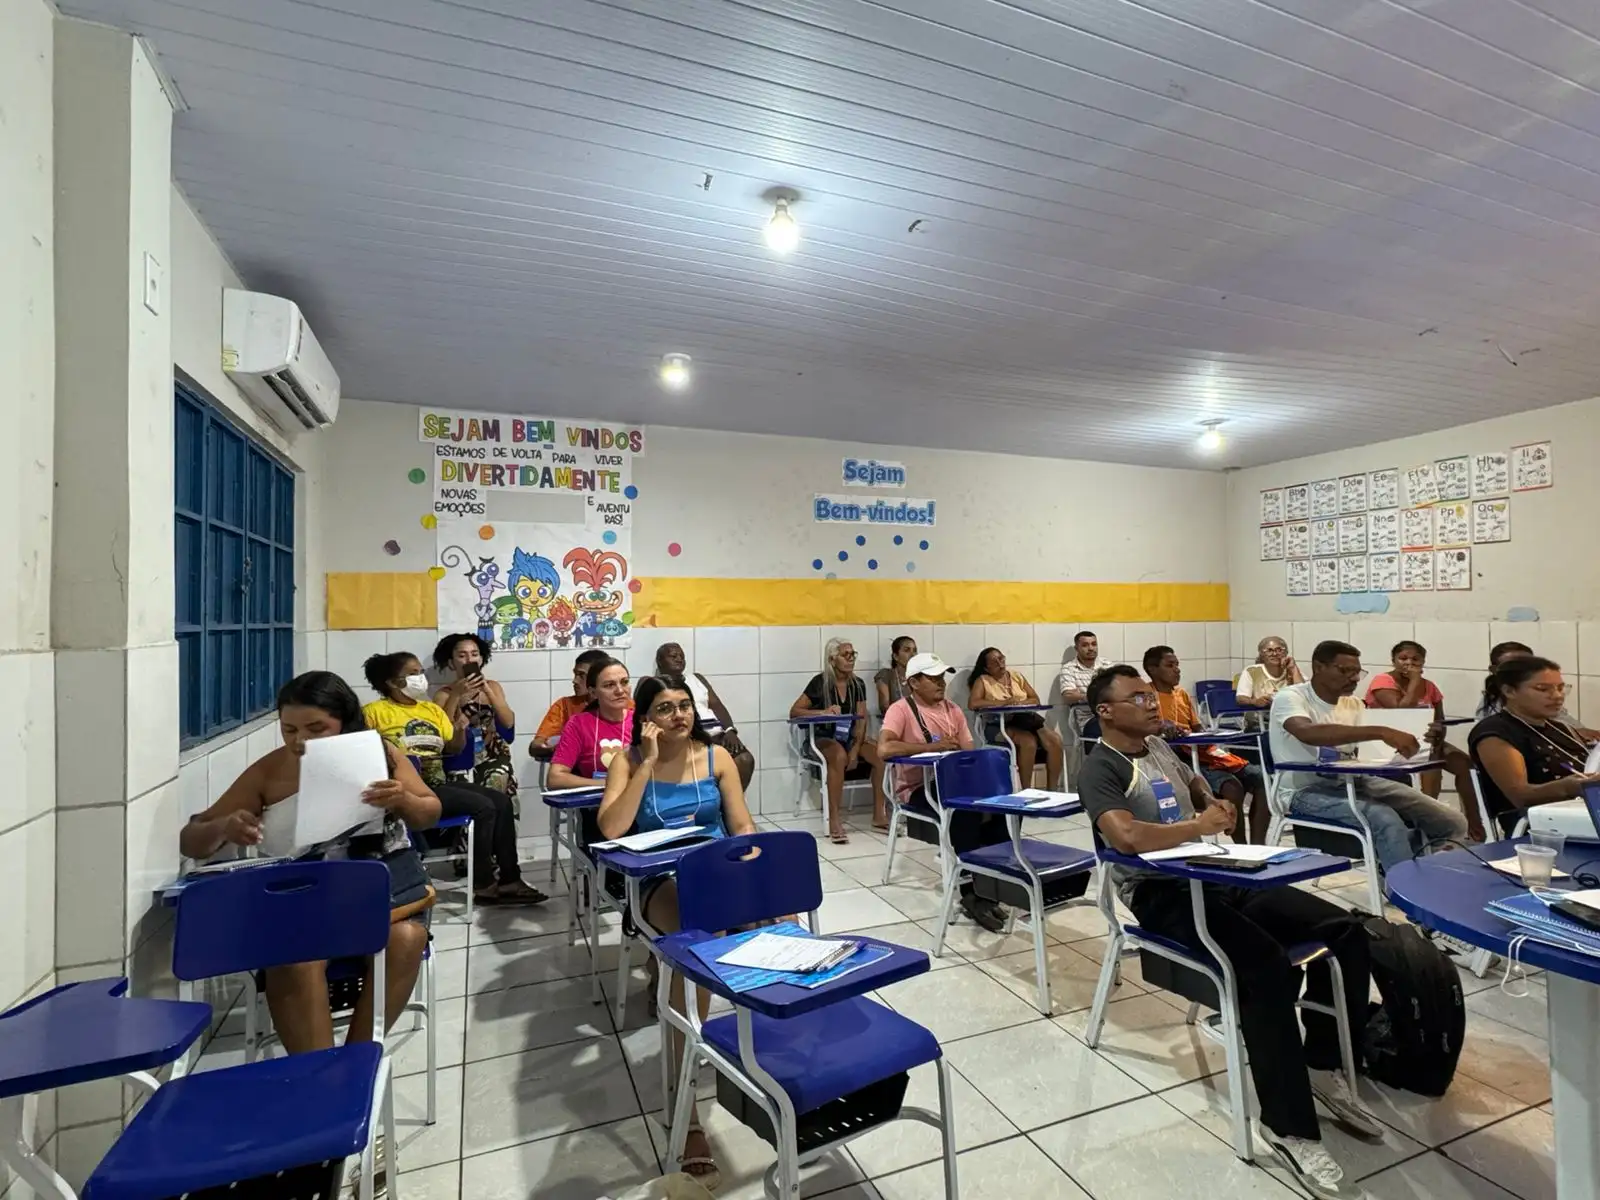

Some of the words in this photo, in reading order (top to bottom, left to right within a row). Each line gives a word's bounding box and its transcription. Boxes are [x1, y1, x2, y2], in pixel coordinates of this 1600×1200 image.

[423, 414, 500, 442] SEJAM
[512, 419, 556, 443] BEM
[566, 427, 642, 452] VINDOS
[436, 446, 486, 459] ESTAMOS
[492, 448, 508, 458] DE
[511, 449, 542, 460] VOLTA
[552, 453, 576, 464] PARA
[594, 455, 623, 466] VIVER
[441, 459, 620, 493] DIVERTIDAMENTE
[844, 459, 905, 485] Sejam
[441, 489, 477, 500] NOVAS
[588, 496, 593, 505] E
[435, 502, 485, 517] EMOÇÕES
[596, 504, 630, 514] AVENTU
[815, 497, 936, 525] Bem-vindos!
[604, 515, 624, 526] RAS!
